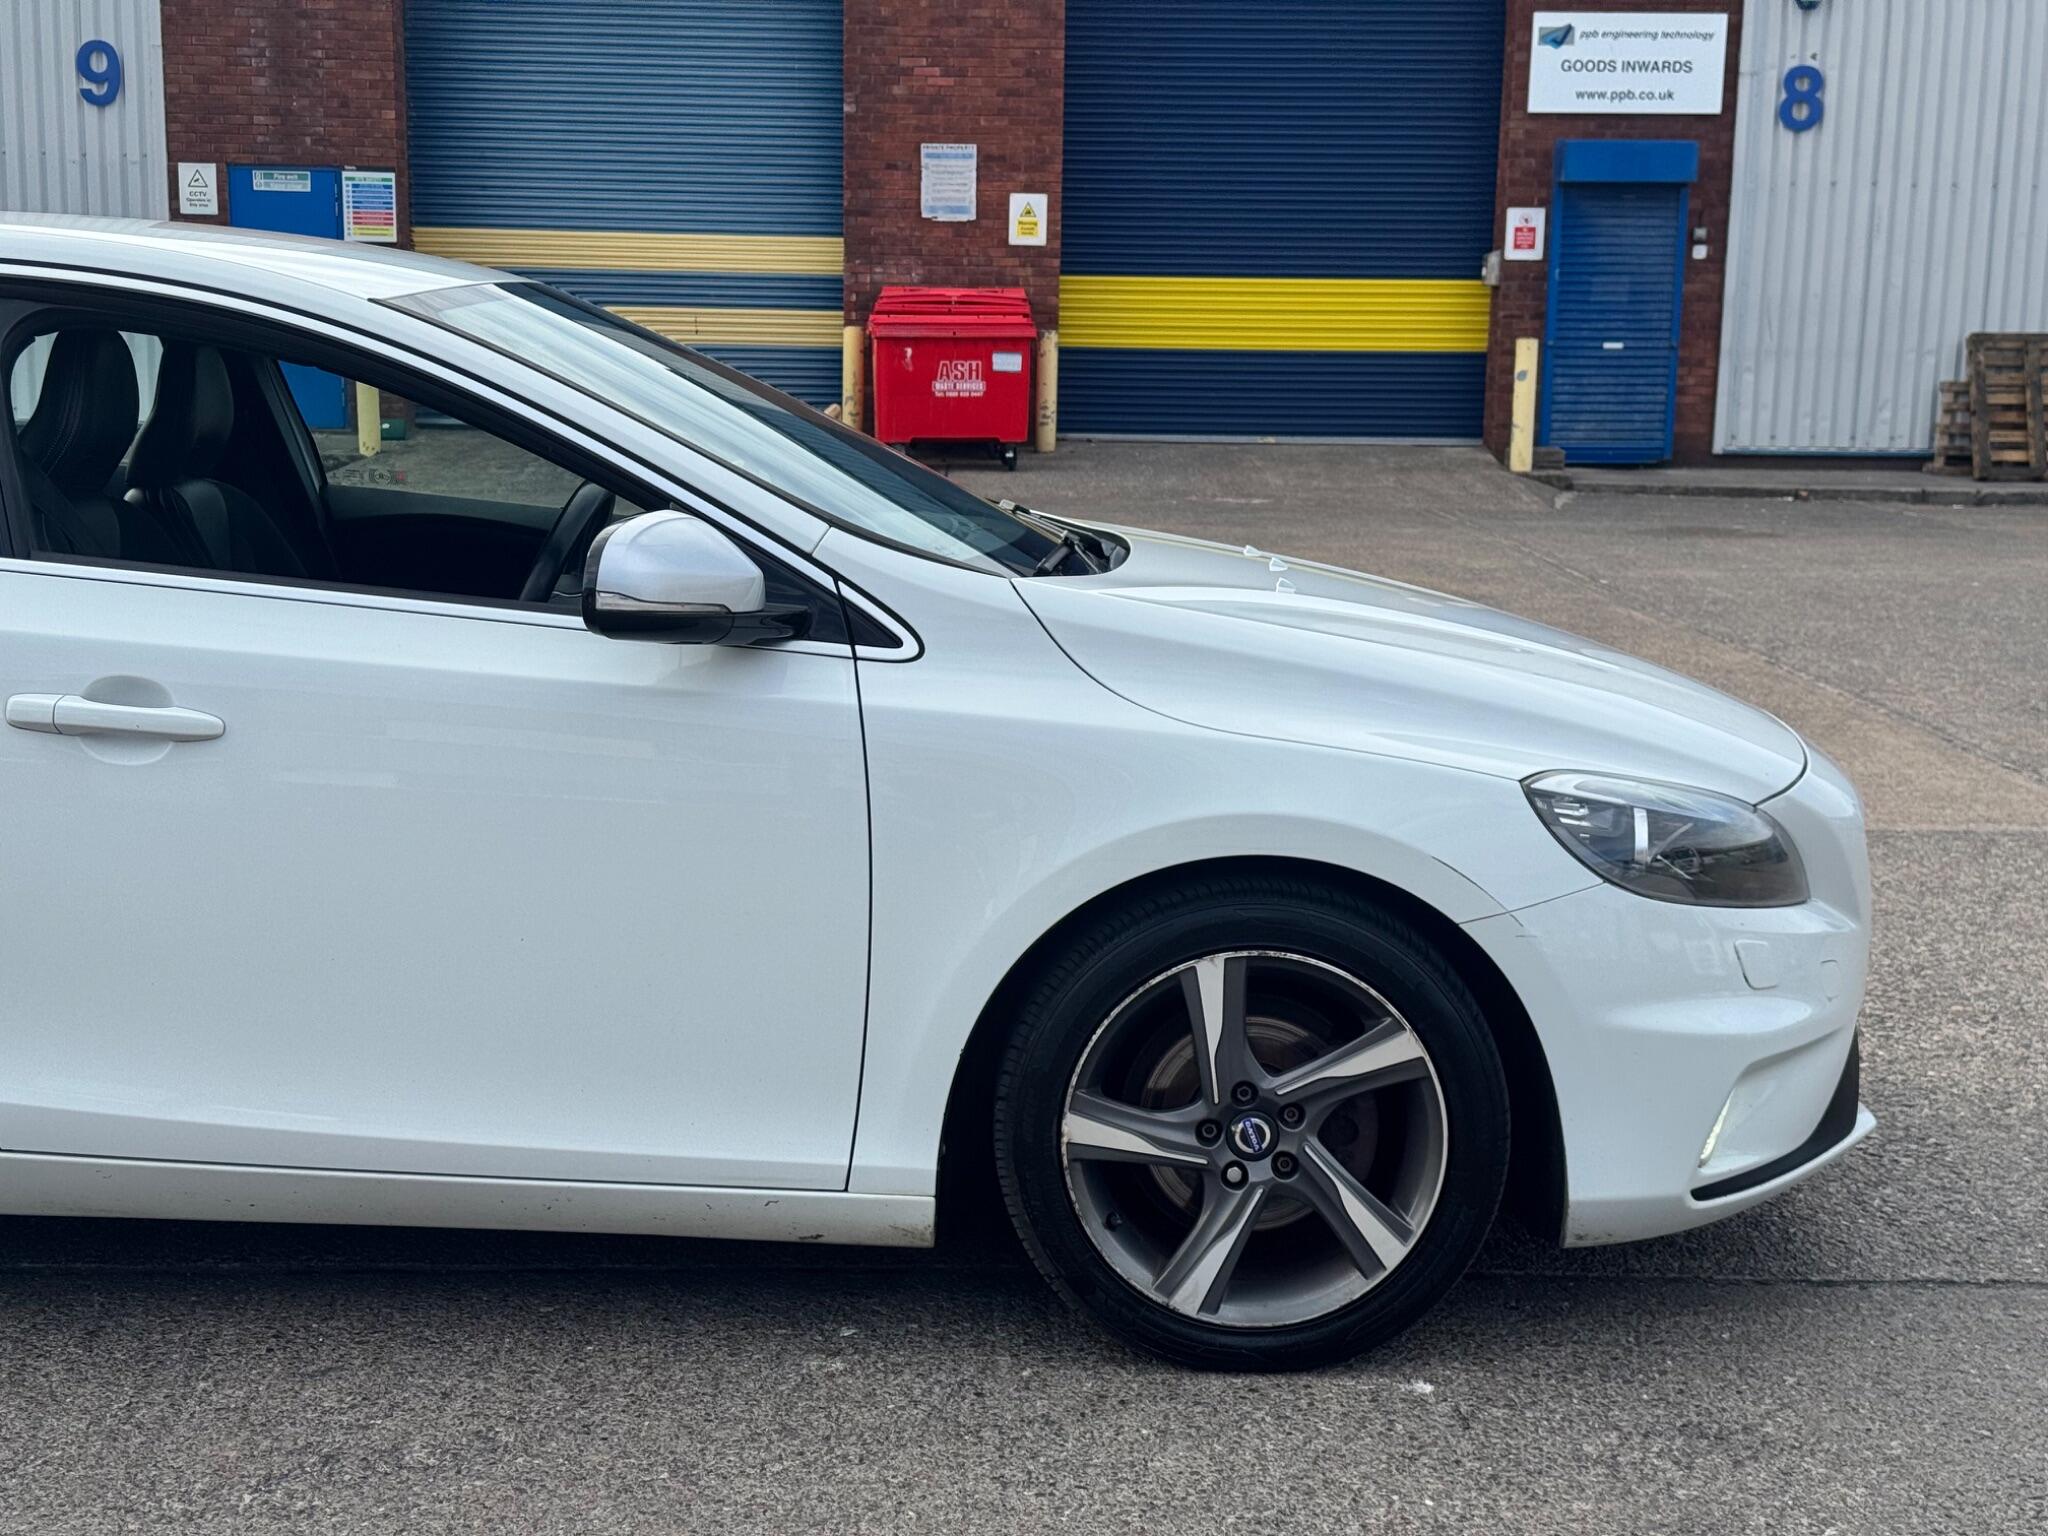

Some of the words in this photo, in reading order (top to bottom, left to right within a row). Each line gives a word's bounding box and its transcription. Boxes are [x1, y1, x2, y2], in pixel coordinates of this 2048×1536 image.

[1579, 30, 1598, 40] ppb
[1601, 30, 1659, 40] engineering
[1661, 30, 1714, 41] technology
[76, 39, 121, 107] 9
[1561, 59, 1617, 73] GOODS
[1621, 60, 1693, 74] INWARDS
[1576, 90, 1674, 102] www.ppb.co.uk
[1779, 65, 1825, 132] 8
[937, 360, 982, 381] ASH
[1244, 1120, 1261, 1151] VOLVO
